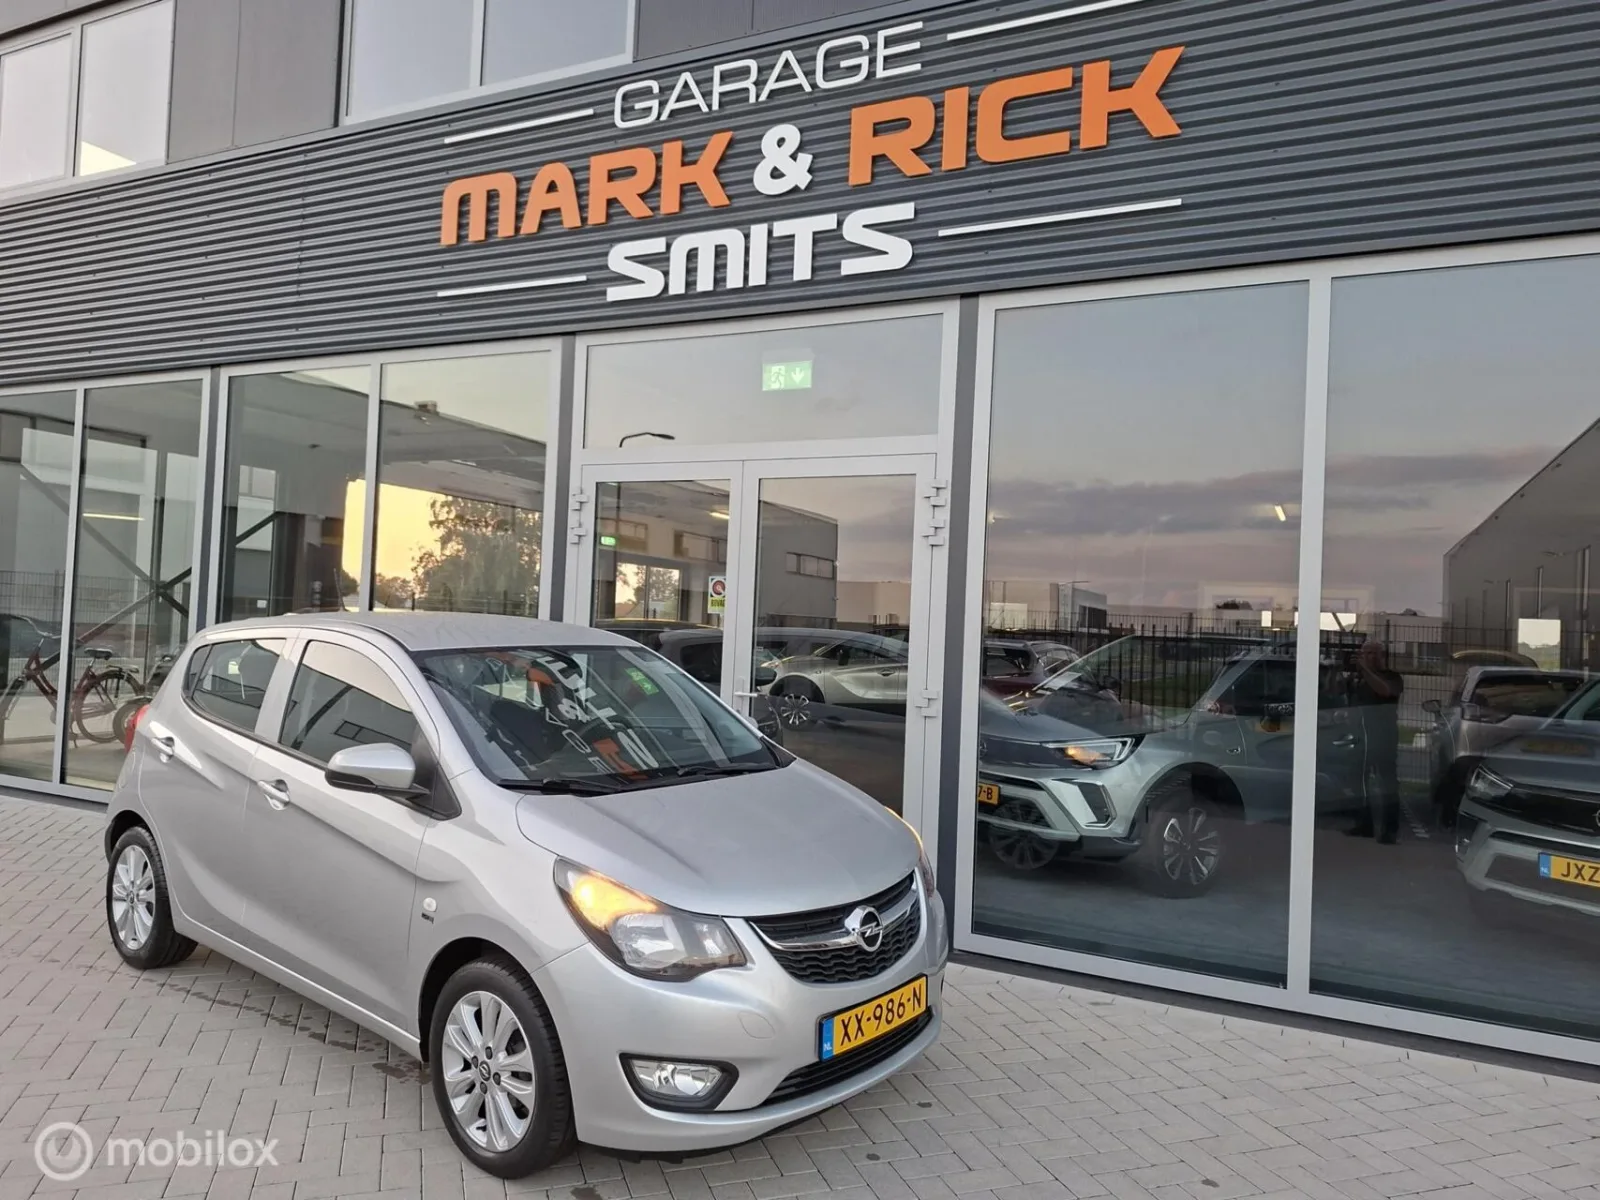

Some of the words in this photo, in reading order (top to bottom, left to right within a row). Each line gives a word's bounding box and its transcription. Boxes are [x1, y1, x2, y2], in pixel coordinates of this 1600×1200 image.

[613, 21, 923, 129] GARAGE
[440, 131, 734, 246] MARK
[752, 123, 814, 196] &
[848, 46, 1185, 186] RICK
[605, 202, 916, 303] SMITS
[840, 983, 922, 1047] XX-986-N
